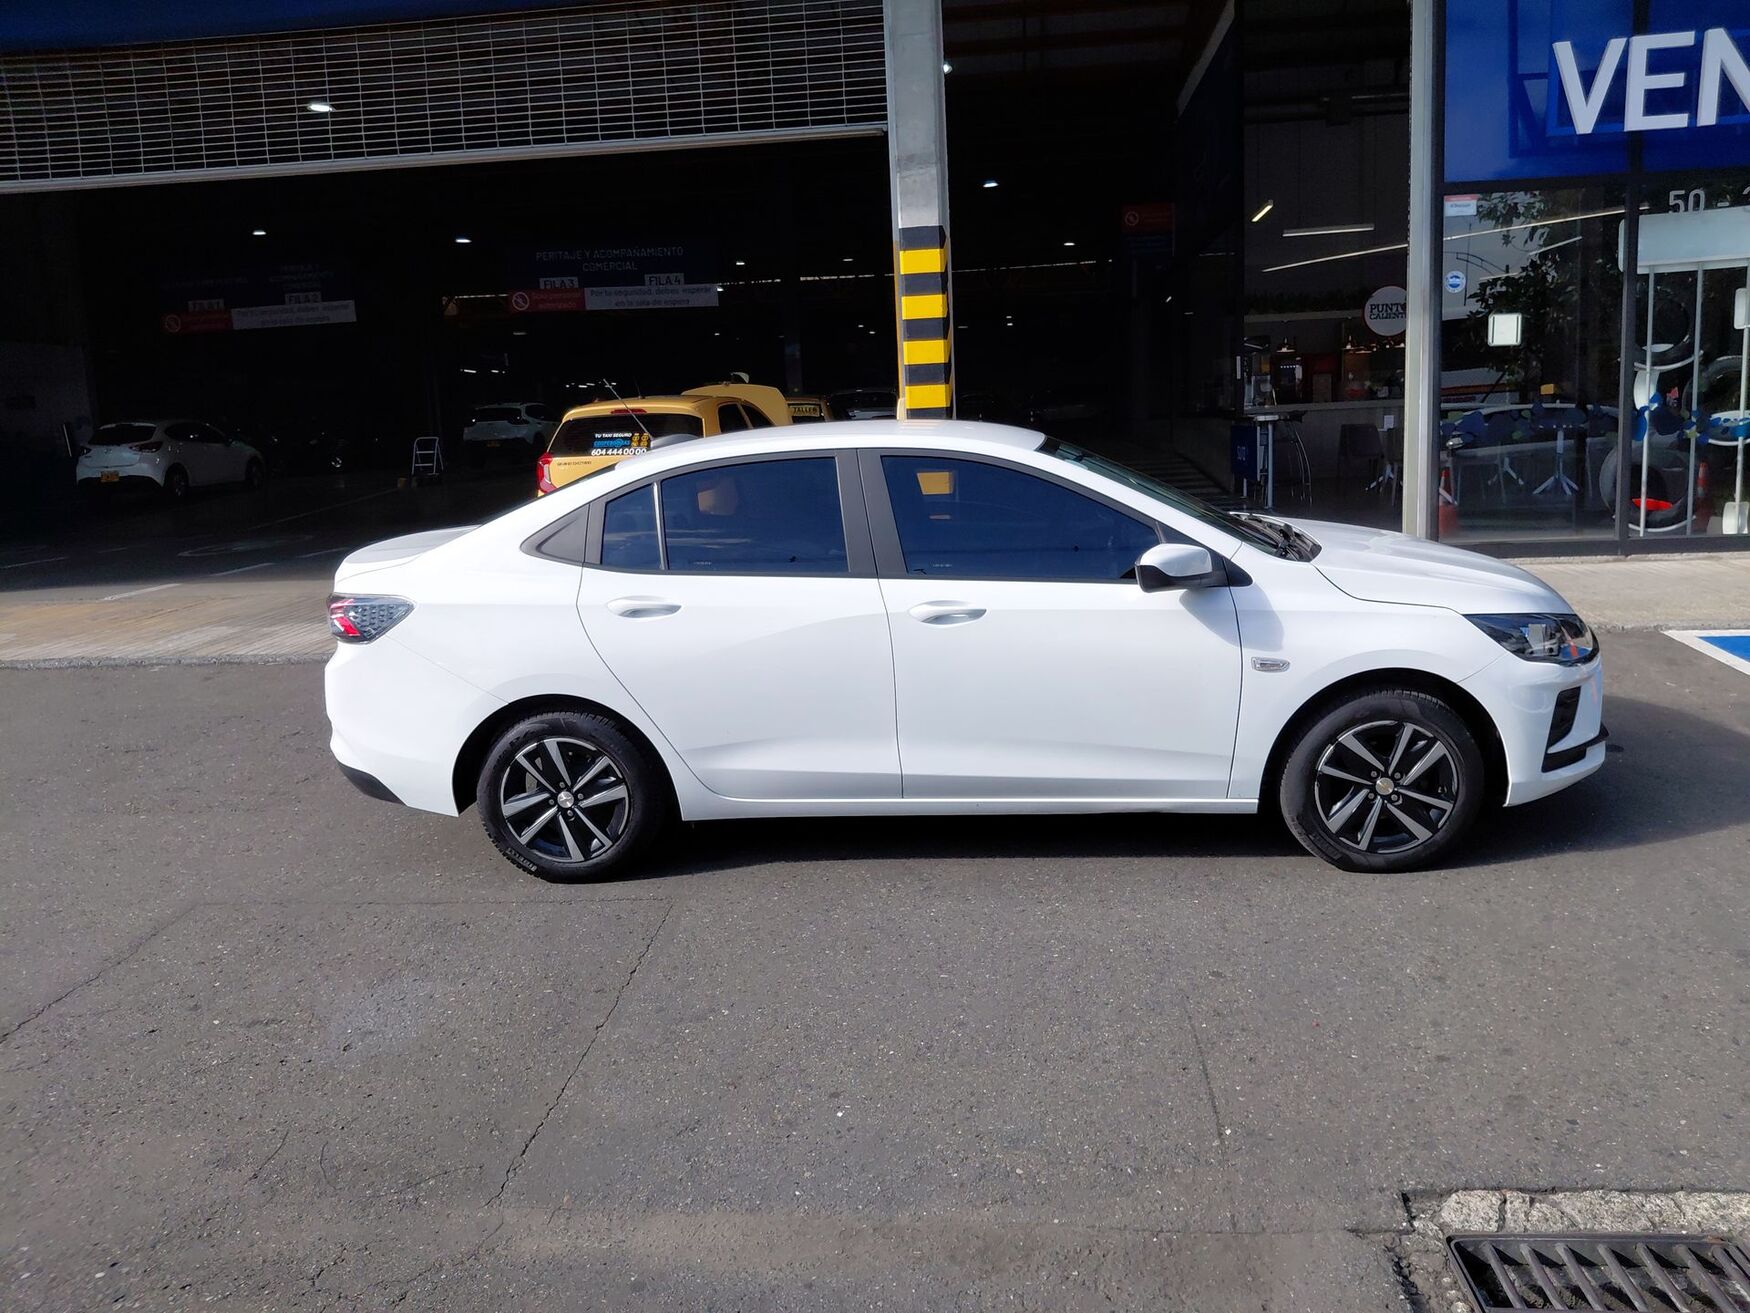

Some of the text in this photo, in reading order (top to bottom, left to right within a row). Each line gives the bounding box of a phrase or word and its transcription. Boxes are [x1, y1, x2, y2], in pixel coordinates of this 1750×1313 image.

[1552, 27, 1750, 135] VEN
[1669, 188, 1705, 213] 50
[582, 261, 638, 272] COMERCIAL
[543, 278, 567, 288] FILA
[649, 275, 681, 285] FILA 4
